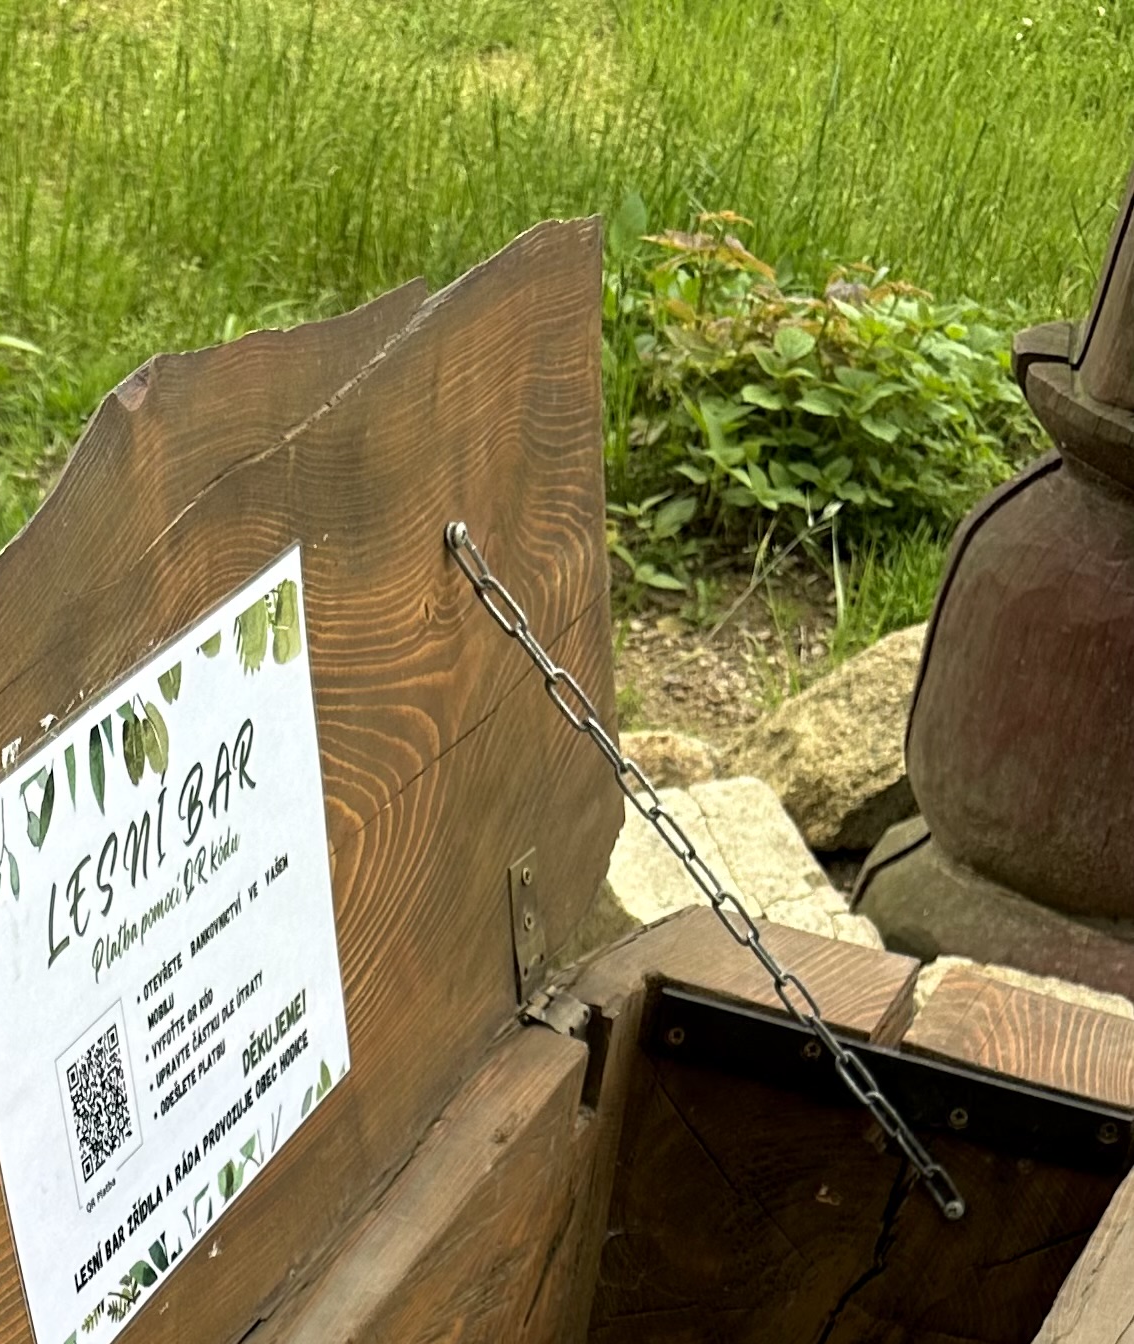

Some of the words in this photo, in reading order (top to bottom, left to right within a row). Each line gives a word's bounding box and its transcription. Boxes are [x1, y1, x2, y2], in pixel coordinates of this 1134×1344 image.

[48, 768, 167, 969] LESNÍ
[178, 718, 256, 846] BAR
[91, 918, 139, 984] Platba
[141, 872, 182, 946] pomocí
[183, 846, 208, 903] QR
[143, 952, 183, 1002] OTEVŘETE
[190, 891, 242, 958] BANKOVNICTVÍ
[248, 880, 258, 902] VE
[265, 853, 288, 886] VAŠEM
[156, 1042, 191, 1089] UPRAVTE
[192, 1012, 220, 1051] ČÁSTKU
[222, 998, 235, 1022] DLE
[236, 970, 263, 1008] ÚTRATY
[160, 1071, 196, 1116] ODEŠLETE
[198, 1038, 226, 1080] PLATBU
[187, 1007, 198, 1028] QR
[242, 988, 307, 1078] DĚKUJEME!
[74, 1241, 103, 1294] LESNÍ
[105, 1225, 126, 1262] BAR
[127, 1185, 163, 1236] ZŘÍDILA
[165, 1174, 174, 1197] A
[175, 1145, 201, 1184] RÁDA
[202, 1086, 254, 1158] PROVOZUJE
[255, 1064, 278, 1099] OBEC
[279, 1029, 309, 1075] HODICE
